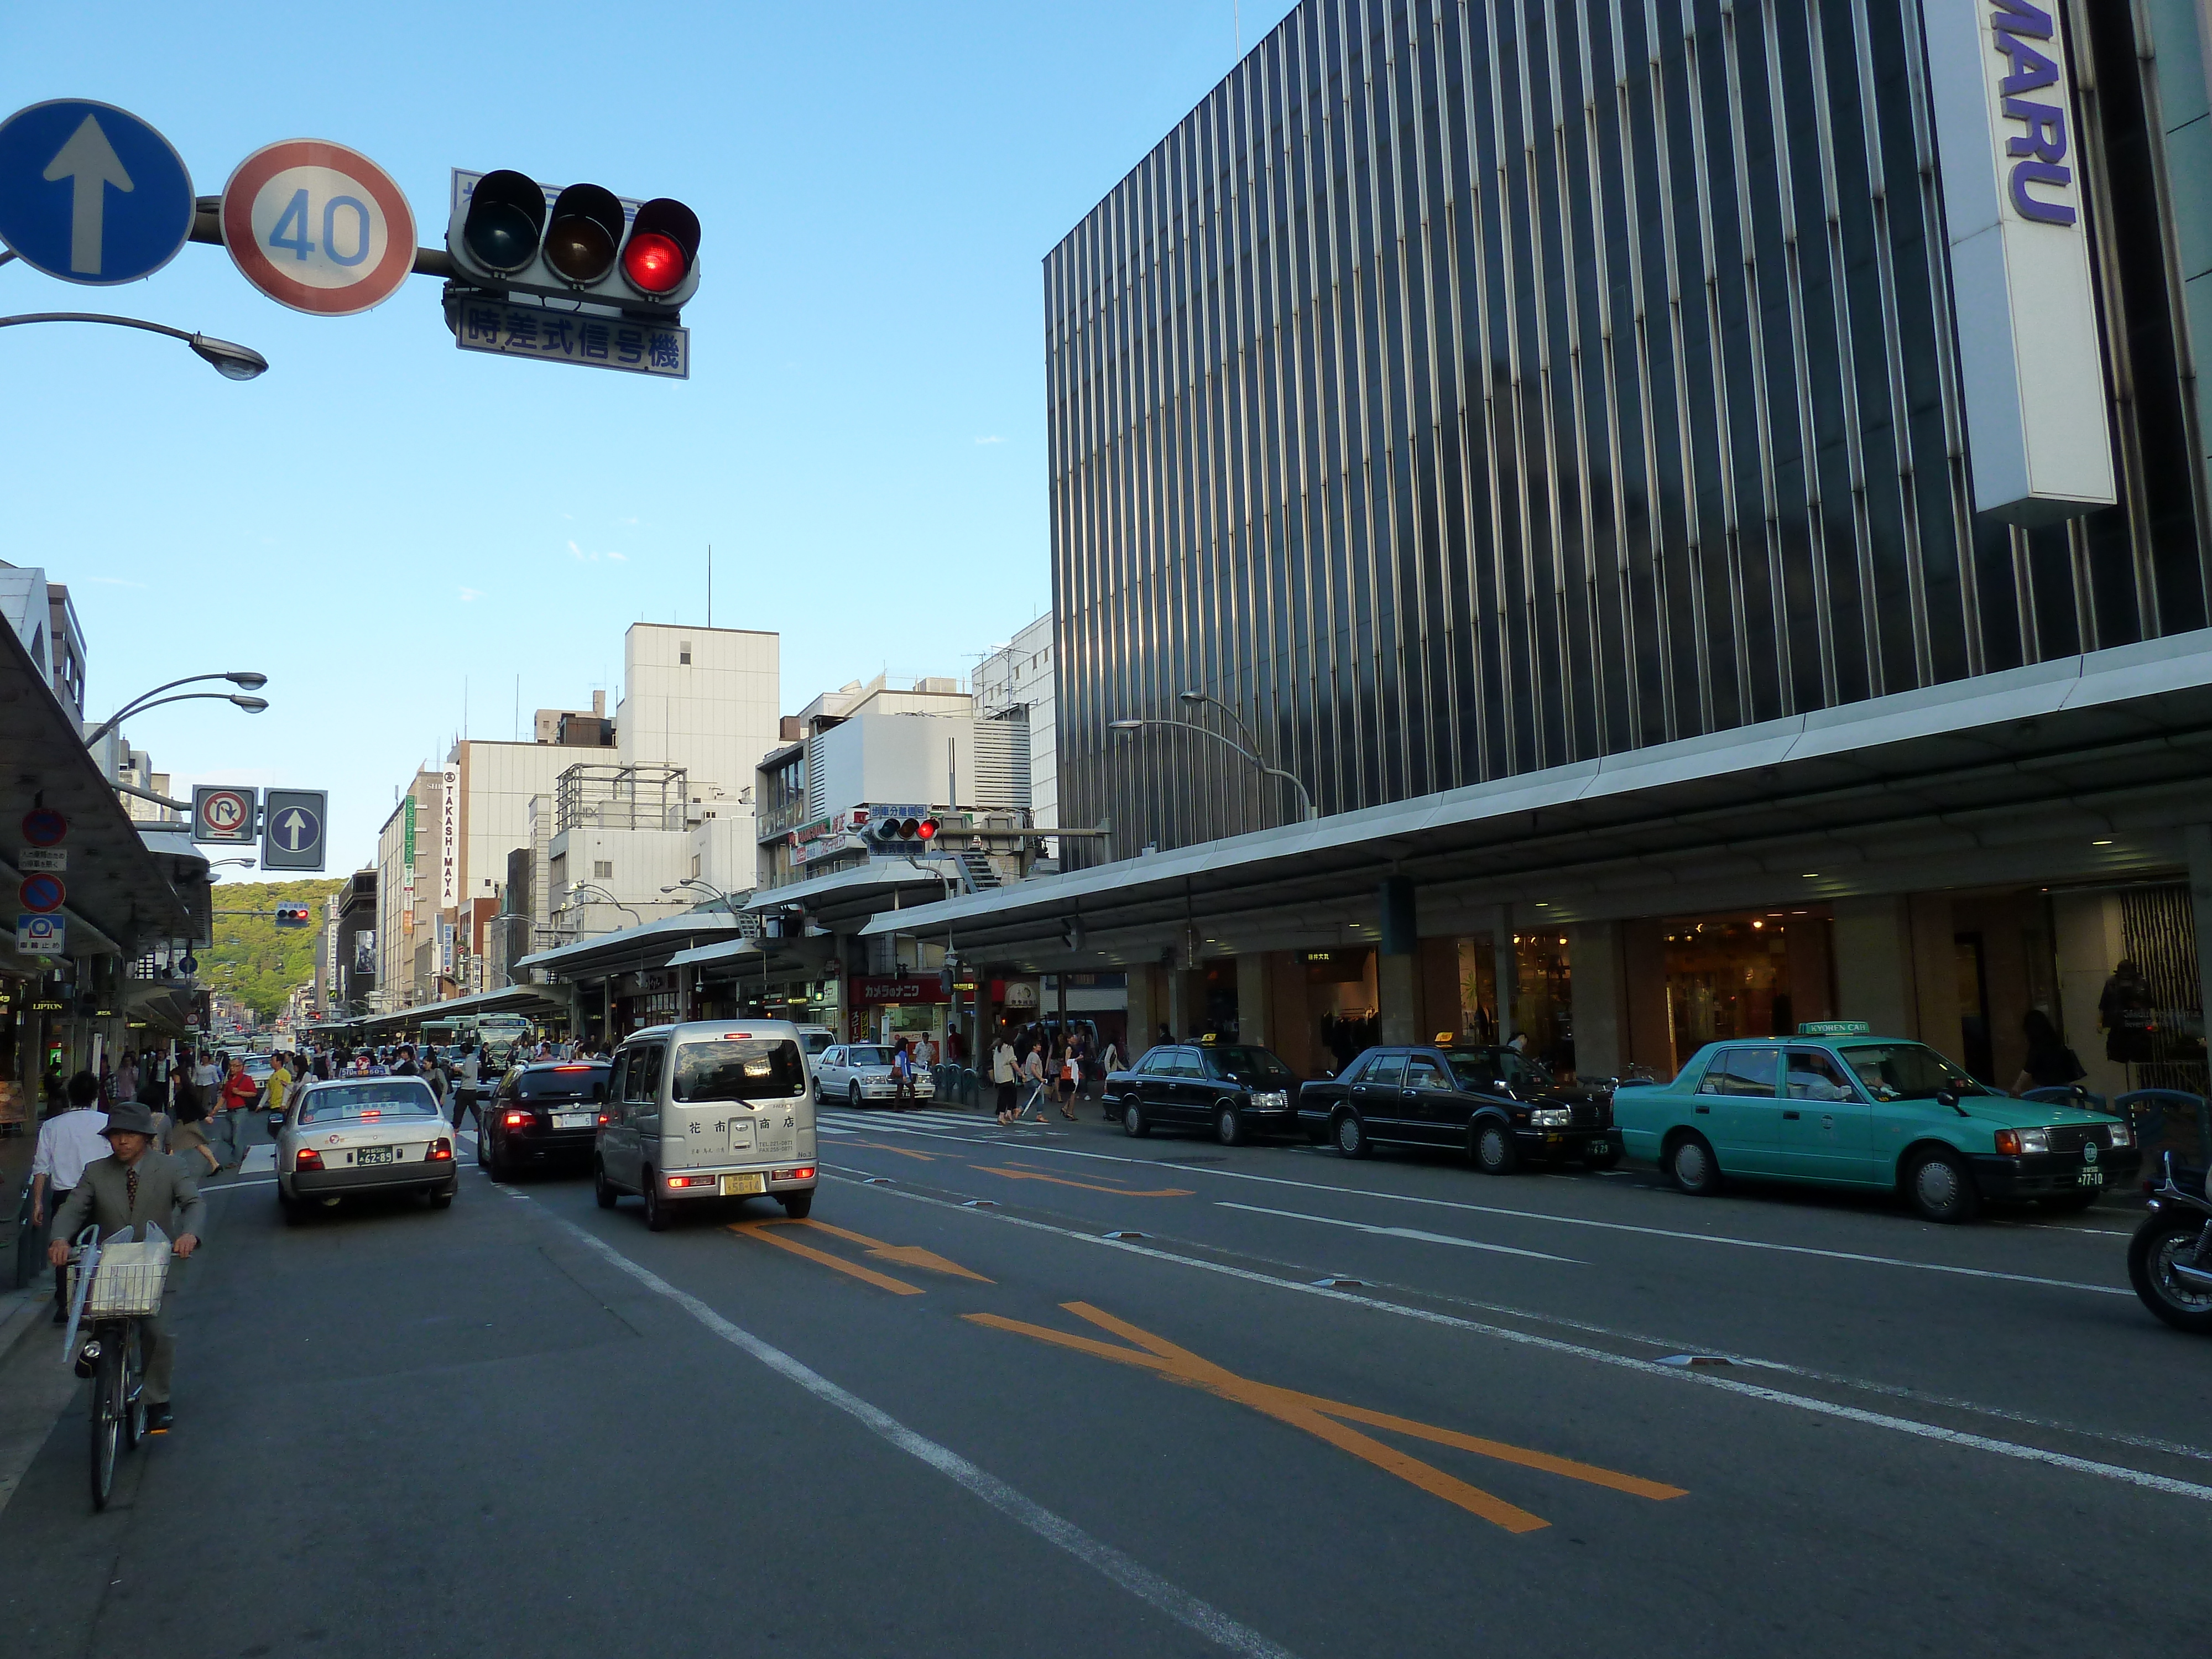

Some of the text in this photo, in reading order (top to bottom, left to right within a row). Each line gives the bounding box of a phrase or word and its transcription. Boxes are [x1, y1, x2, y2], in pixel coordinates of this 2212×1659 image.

[269, 189, 371, 267] 40
[468, 308, 680, 369] 時差式信号機
[872, 806, 925, 817] 歩車分離信号
[444, 786, 453, 897] TAKASHIMAYA
[865, 984, 919, 998] カメラのナニワ
[365, 1152, 392, 1164] 62-89
[2081, 1173, 2103, 1186] 77-10
